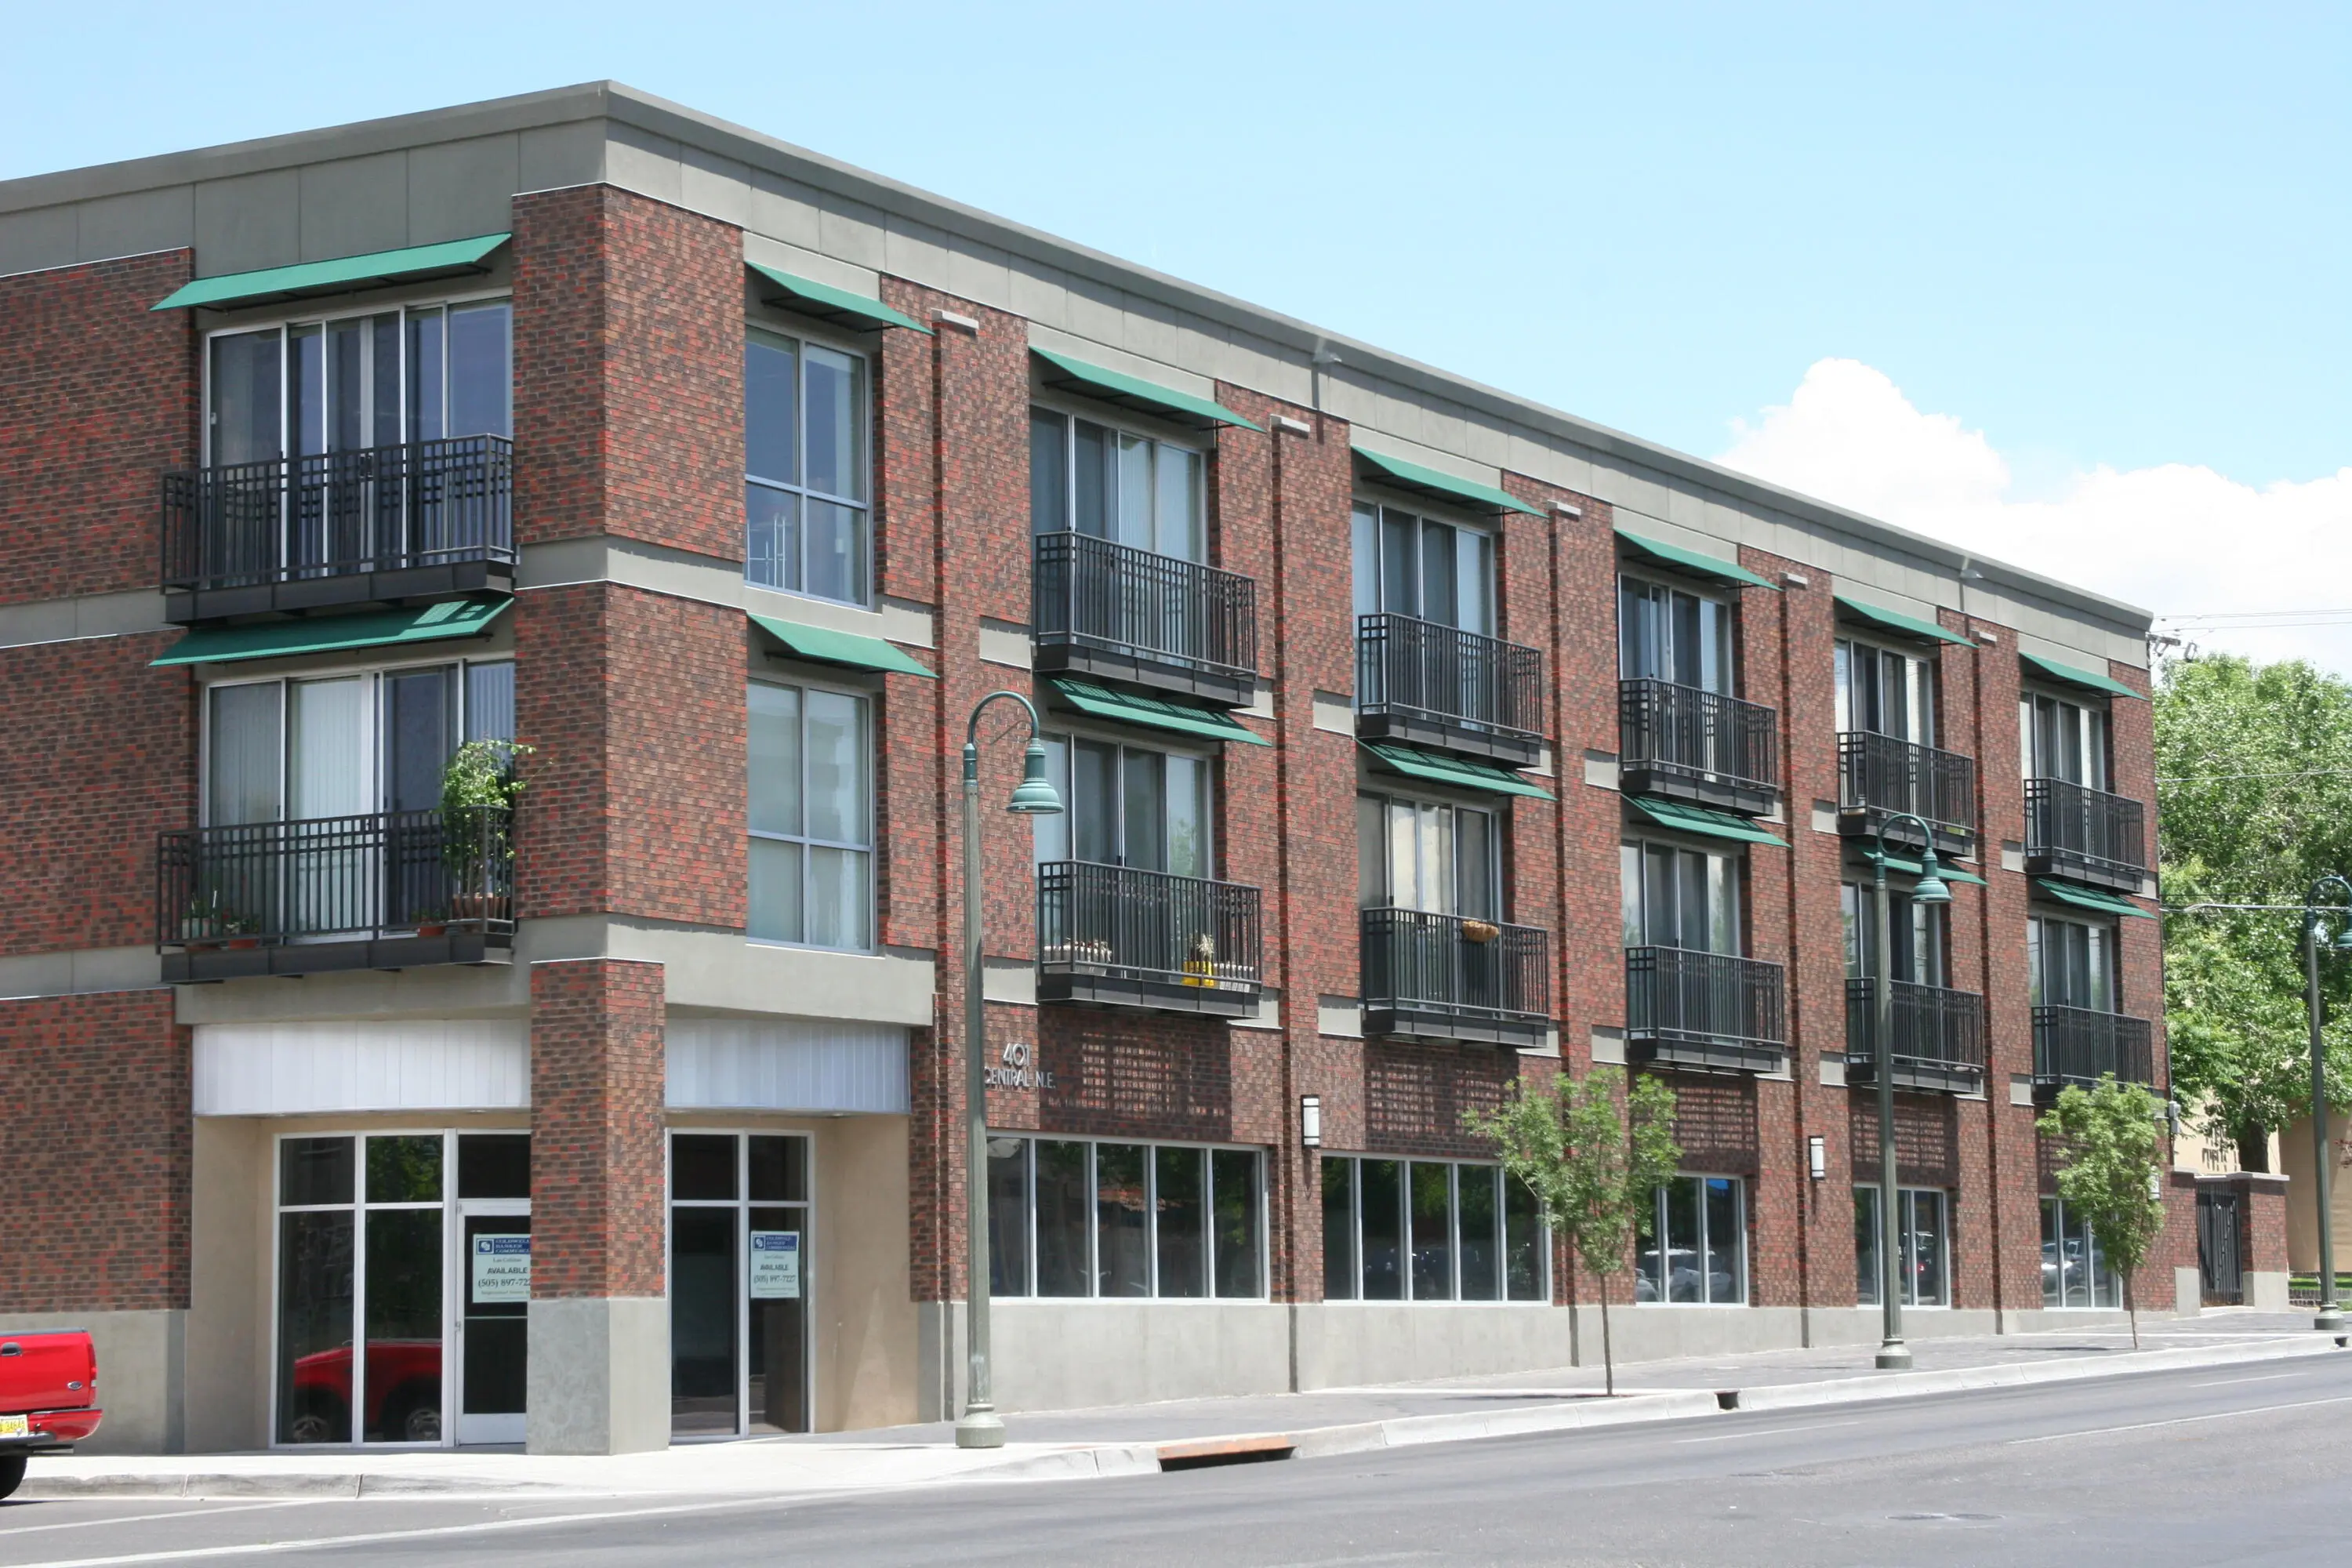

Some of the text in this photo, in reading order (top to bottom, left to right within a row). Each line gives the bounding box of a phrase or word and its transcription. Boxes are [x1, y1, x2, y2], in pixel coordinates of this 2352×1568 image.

[1004, 1043, 1030, 1066] 401
[984, 1066, 1056, 1088] CENTRAL N.E.
[478, 1279, 498, 1288] (505)
